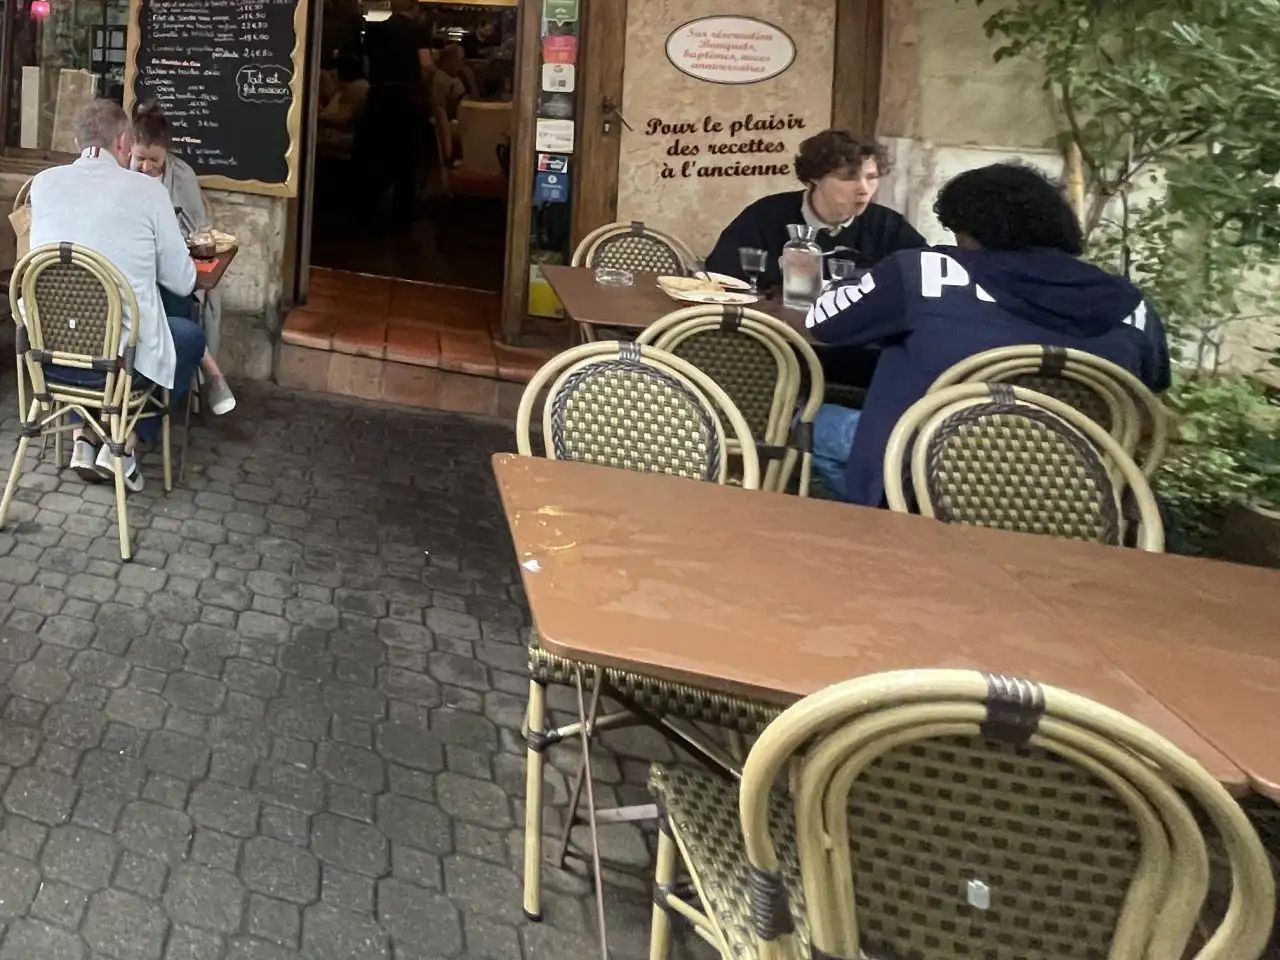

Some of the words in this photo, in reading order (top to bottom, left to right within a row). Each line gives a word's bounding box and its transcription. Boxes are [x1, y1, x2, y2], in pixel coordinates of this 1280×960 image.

[257, 87, 289, 96] maison
[645, 117, 698, 135] Pour
[703, 115, 724, 133] le
[729, 113, 806, 137] plaisir
[666, 139, 700, 156] des
[707, 138, 786, 155] recettes
[660, 162, 675, 179] à
[681, 160, 790, 178] l'ancienne
